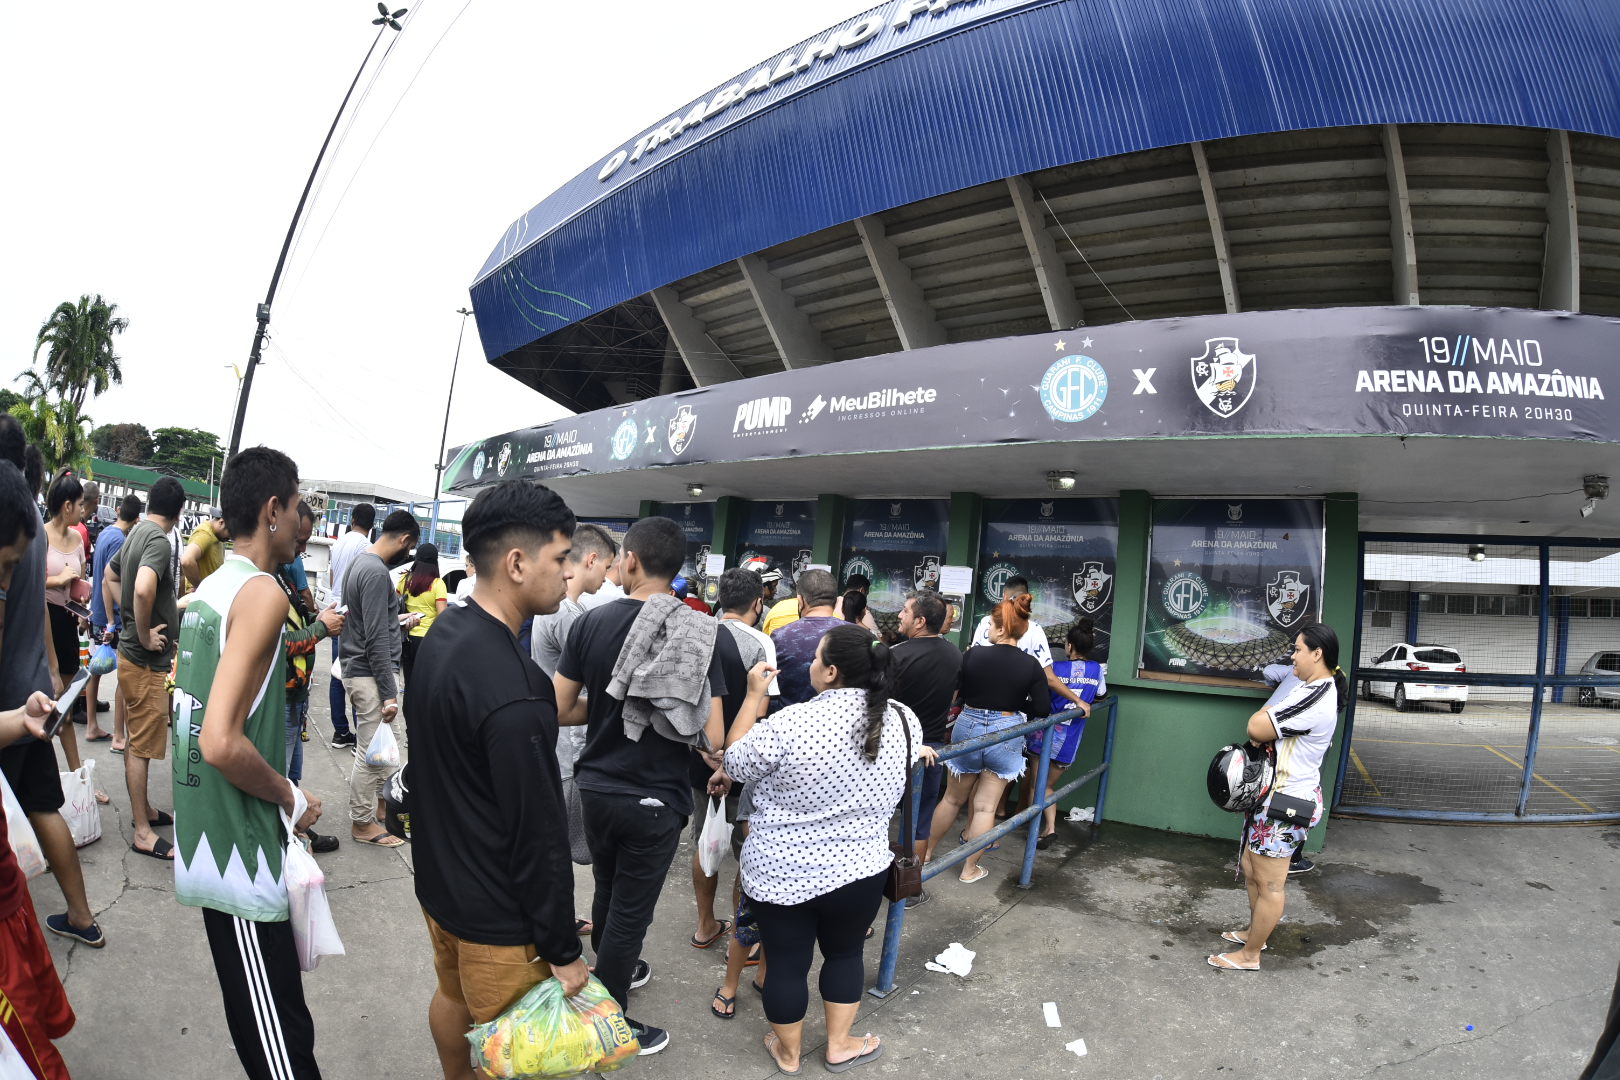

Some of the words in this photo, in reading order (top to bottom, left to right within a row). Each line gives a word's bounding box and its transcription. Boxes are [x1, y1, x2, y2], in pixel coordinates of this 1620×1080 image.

[597, 149, 628, 183] O
[628, 15, 886, 164] TRABALHO
[1041, 357, 1072, 391] GUARANI
[1086, 359, 1106, 387] CLUBE
[1132, 368, 1158, 395] X
[1355, 370, 1445, 393] ARENA
[1449, 370, 1483, 394] DA
[1486, 368, 1605, 400] AMAZÔNIA
[829, 386, 937, 413] MeuBilhete
[1044, 399, 1084, 421] CAMPINAS
[733, 396, 792, 433] PUMP
[838, 411, 886, 421] INGRESSOS
[890, 408, 925, 417] ONLINE
[1402, 403, 1518, 419] QUINTA-FEIRA
[1525, 406, 1573, 421] 20H30
[526, 451, 546, 463] ARENA
[547, 449, 556, 460] DA
[556, 442, 593, 458] AMAZÔNIA
[893, 531, 925, 539] AMAZÔNIA
[1008, 534, 1032, 542] ARENA
[1033, 534, 1043, 542] DA
[1044, 533, 1085, 543] AMAZÔNIA
[1191, 540, 1219, 548] ARENA
[1221, 540, 1232, 548] DA
[1234, 539, 1278, 550] AMAZÔNIA
